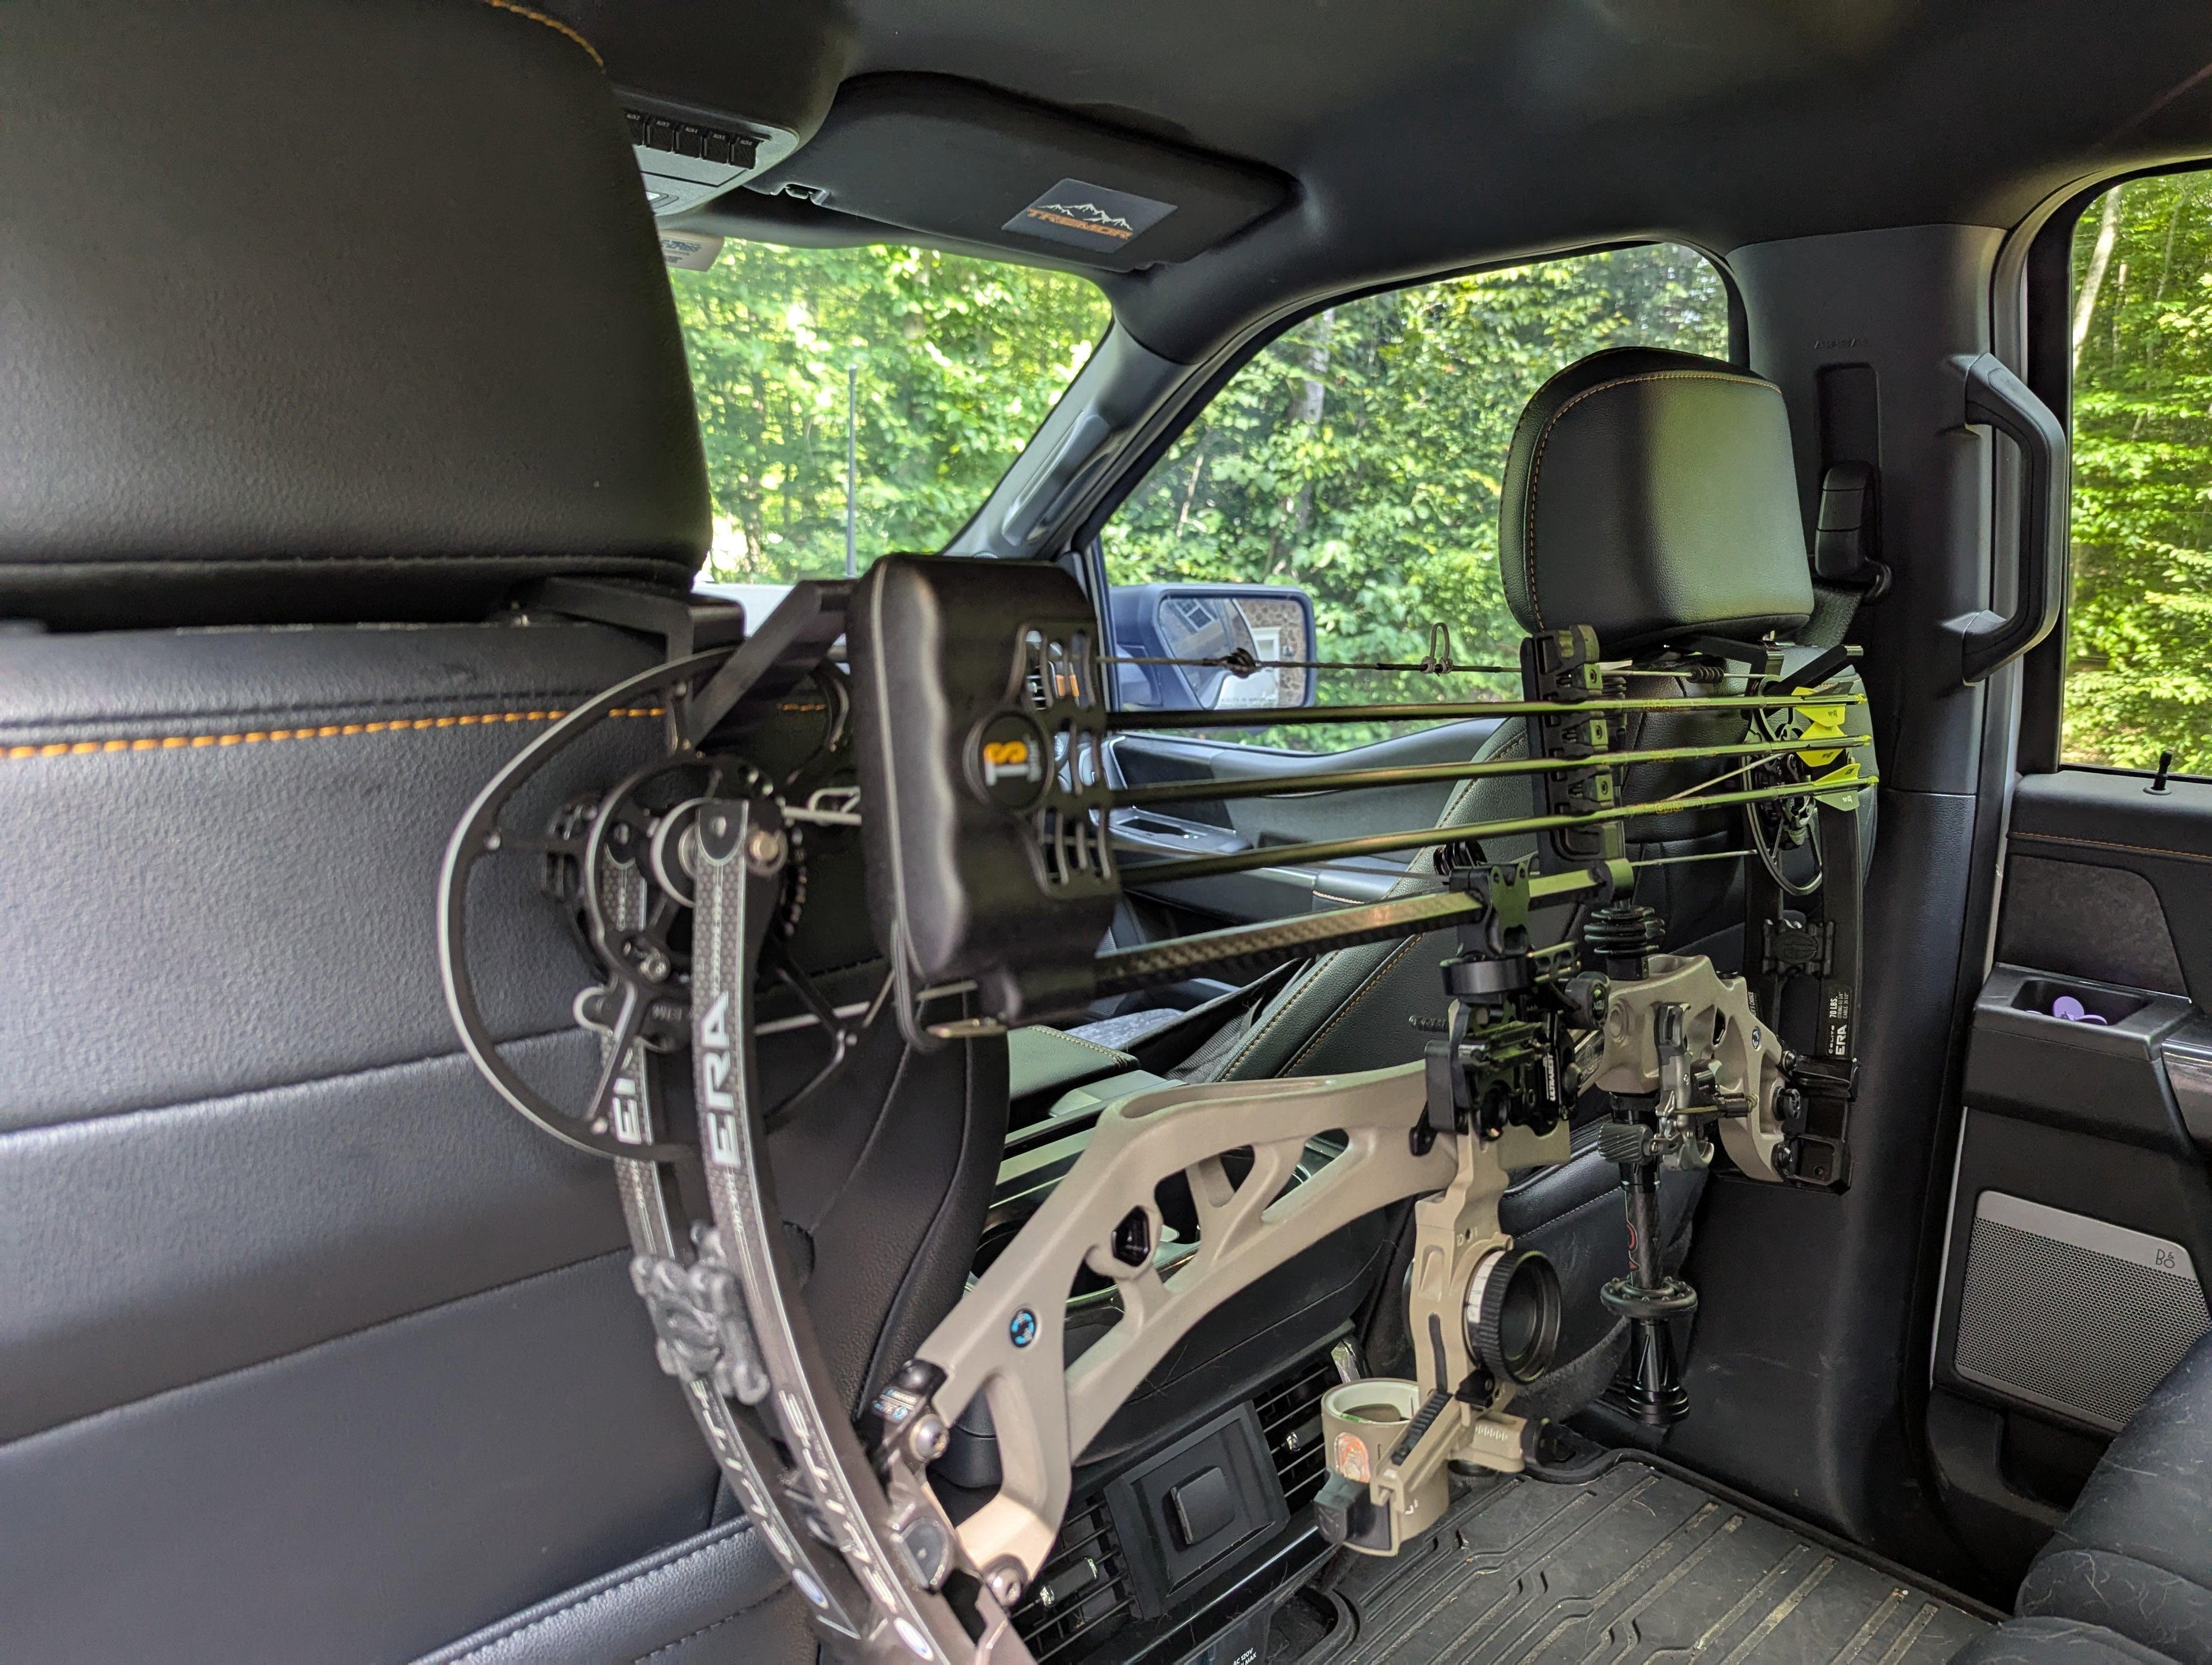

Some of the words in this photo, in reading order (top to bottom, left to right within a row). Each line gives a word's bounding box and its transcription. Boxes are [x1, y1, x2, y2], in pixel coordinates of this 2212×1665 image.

[1027, 207, 1134, 240] TREMOR
[1829, 1010, 1837, 1018] 70
[1835, 1024, 1847, 1056] ERA
[700, 989, 741, 1167] ERA
[1241, 1647, 1253, 1661] 120V
